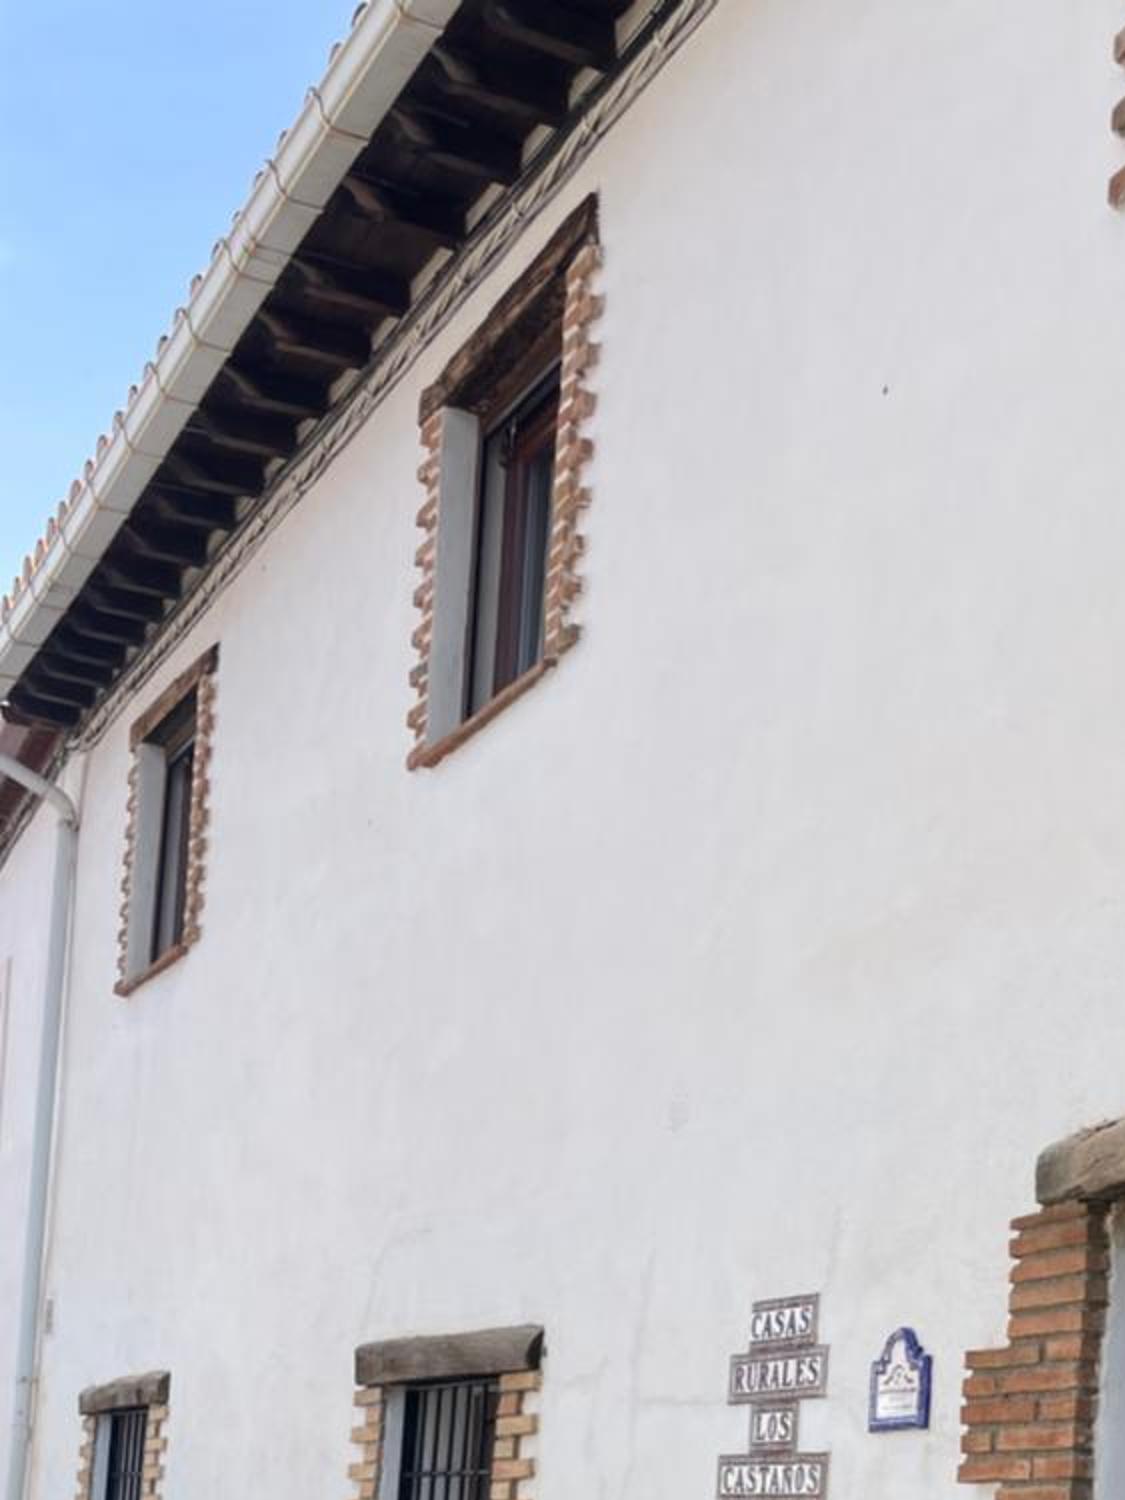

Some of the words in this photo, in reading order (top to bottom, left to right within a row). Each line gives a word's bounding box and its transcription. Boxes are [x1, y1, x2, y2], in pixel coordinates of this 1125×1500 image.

[751, 1306, 811, 1340] CASAS
[735, 1357, 819, 1392] RURALES
[755, 1412, 792, 1441] LOS
